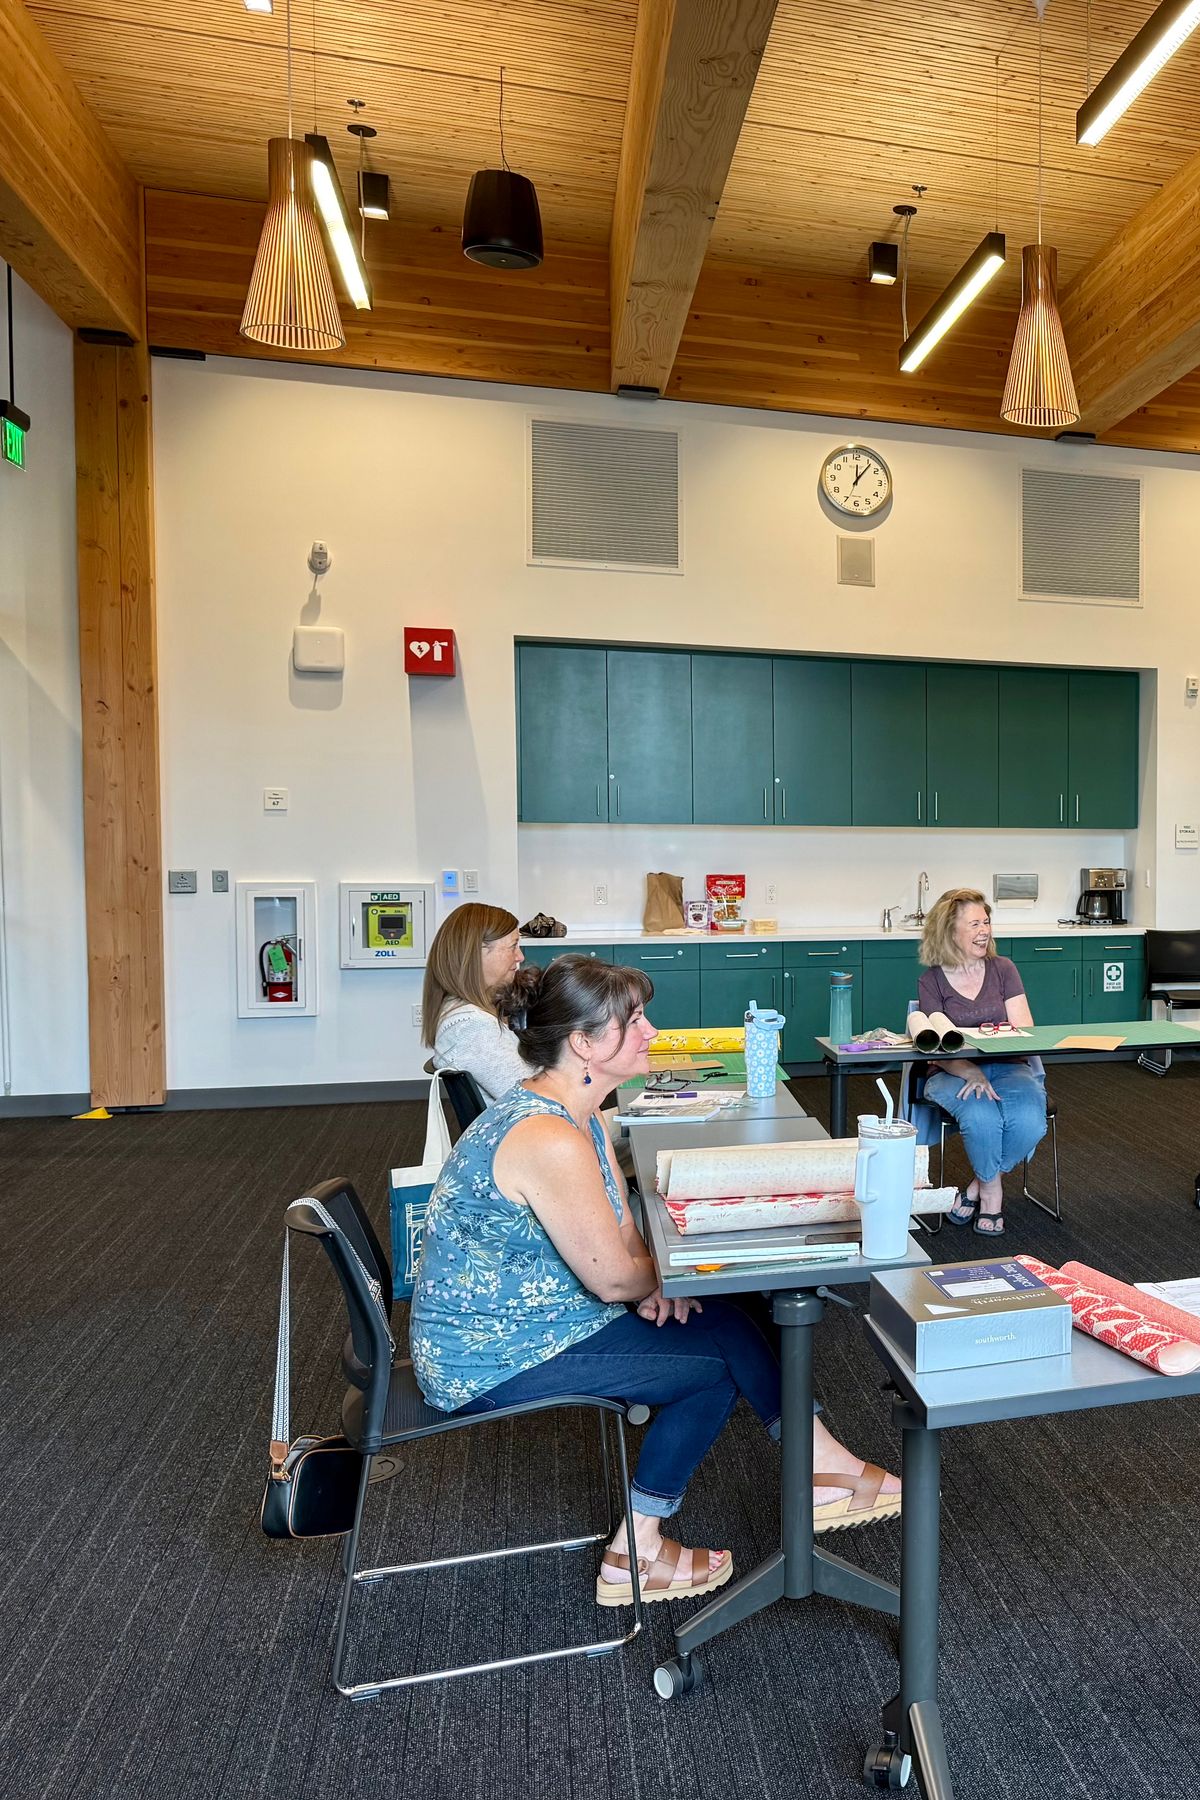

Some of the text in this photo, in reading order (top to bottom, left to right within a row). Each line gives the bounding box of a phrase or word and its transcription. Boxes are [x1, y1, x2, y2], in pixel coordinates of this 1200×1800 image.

[6, 421, 23, 466] EXIT
[852, 453, 861, 461] 12
[833, 463, 841, 471] 10
[1000, 1263, 1018, 1274] fine
[1006, 1273, 1036, 1287] paper
